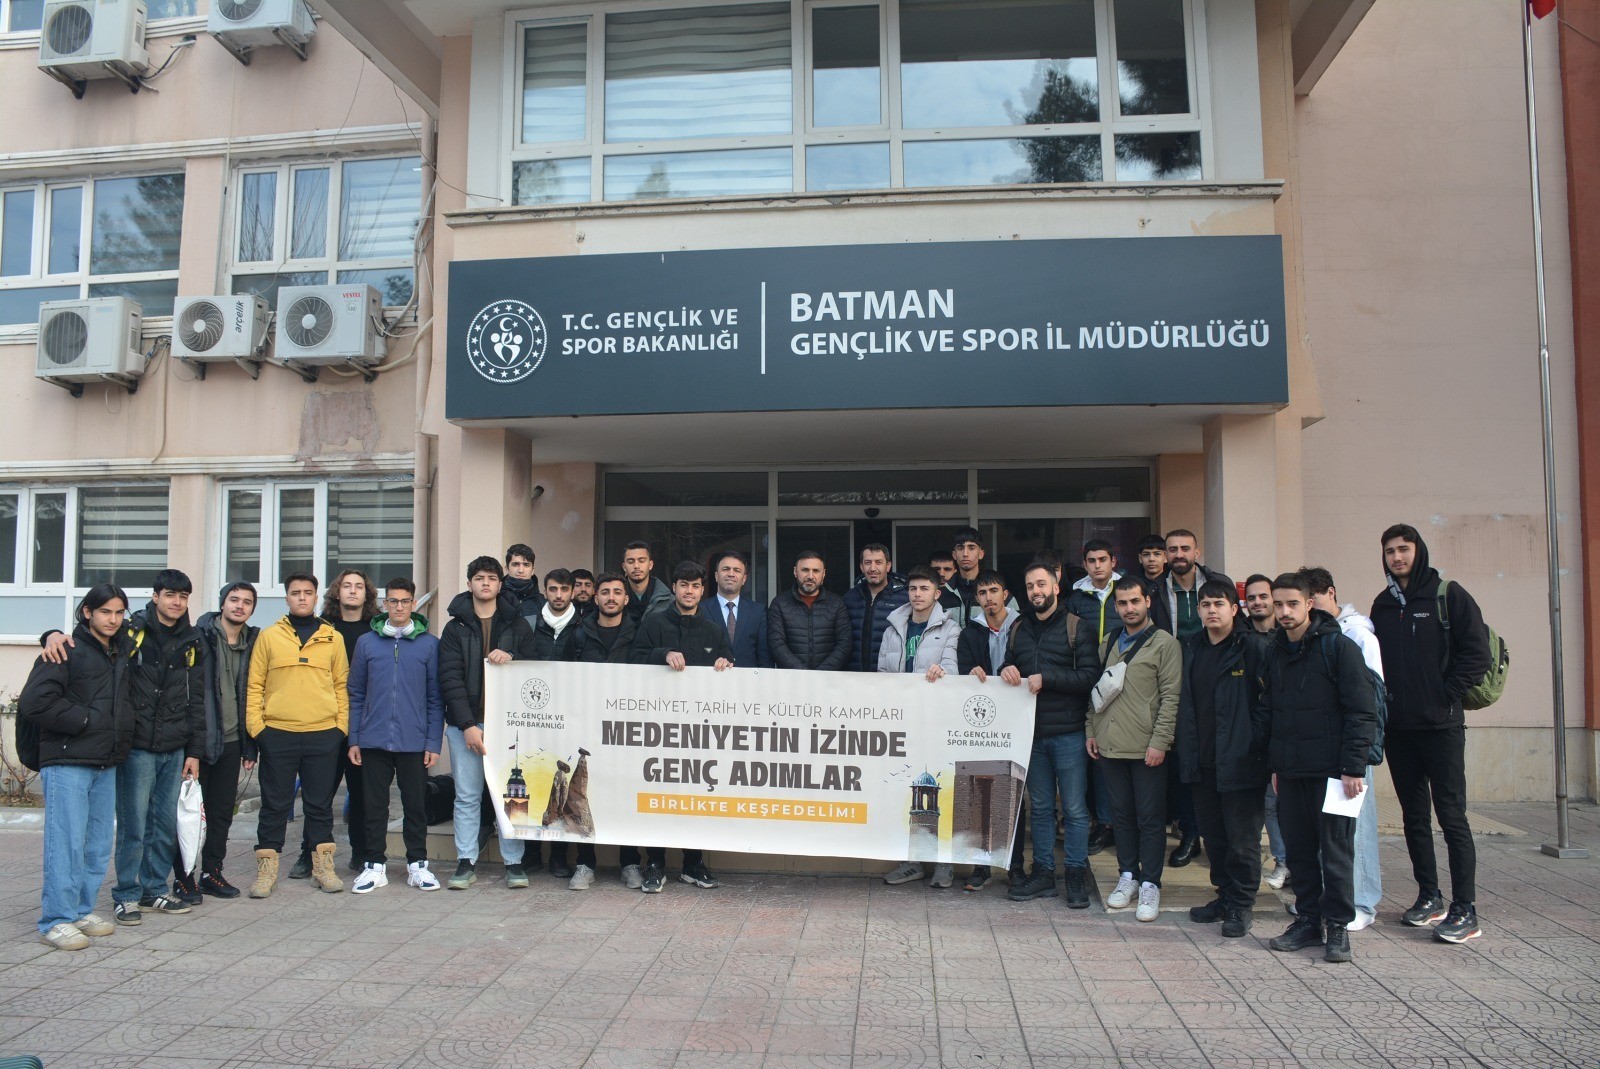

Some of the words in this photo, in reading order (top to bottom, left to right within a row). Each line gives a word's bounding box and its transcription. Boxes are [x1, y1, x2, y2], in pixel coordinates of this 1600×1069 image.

[235, 300, 244, 333] arçelik
[791, 289, 953, 322] BATMAN
[562, 314, 599, 330] T.C.
[607, 307, 702, 332] GENÇLİK
[710, 309, 737, 325] VE
[562, 337, 616, 355] SPOR
[623, 329, 738, 353] BAKANLIĞI
[791, 326, 912, 360] GENÇLİK
[921, 330, 954, 352] VE
[963, 328, 1038, 351] SPOR
[1047, 322, 1070, 349] İL
[1079, 319, 1269, 349] MÜDÜRLÜĞÜ
[521, 713, 552, 721] GENÇLİK
[607, 698, 689, 714] MEDENİYET,
[695, 700, 735, 714] TARİH
[743, 703, 760, 715] VE
[769, 702, 821, 717] KÜLTÜR
[830, 707, 902, 720] KAMPLARI
[527, 720, 564, 729] BAKANLIĞI
[963, 731, 998, 741] GENÇLİK
[602, 719, 799, 753] MEDENİYETİN
[810, 724, 906, 757] İZİNDE
[970, 738, 1011, 748] BAKANLIĞI
[642, 757, 719, 792] GENÇ
[729, 761, 861, 791] ADIMLAR
[649, 797, 729, 813] BİRLİKTE
[736, 801, 856, 818] KEŞFEDELİM!
